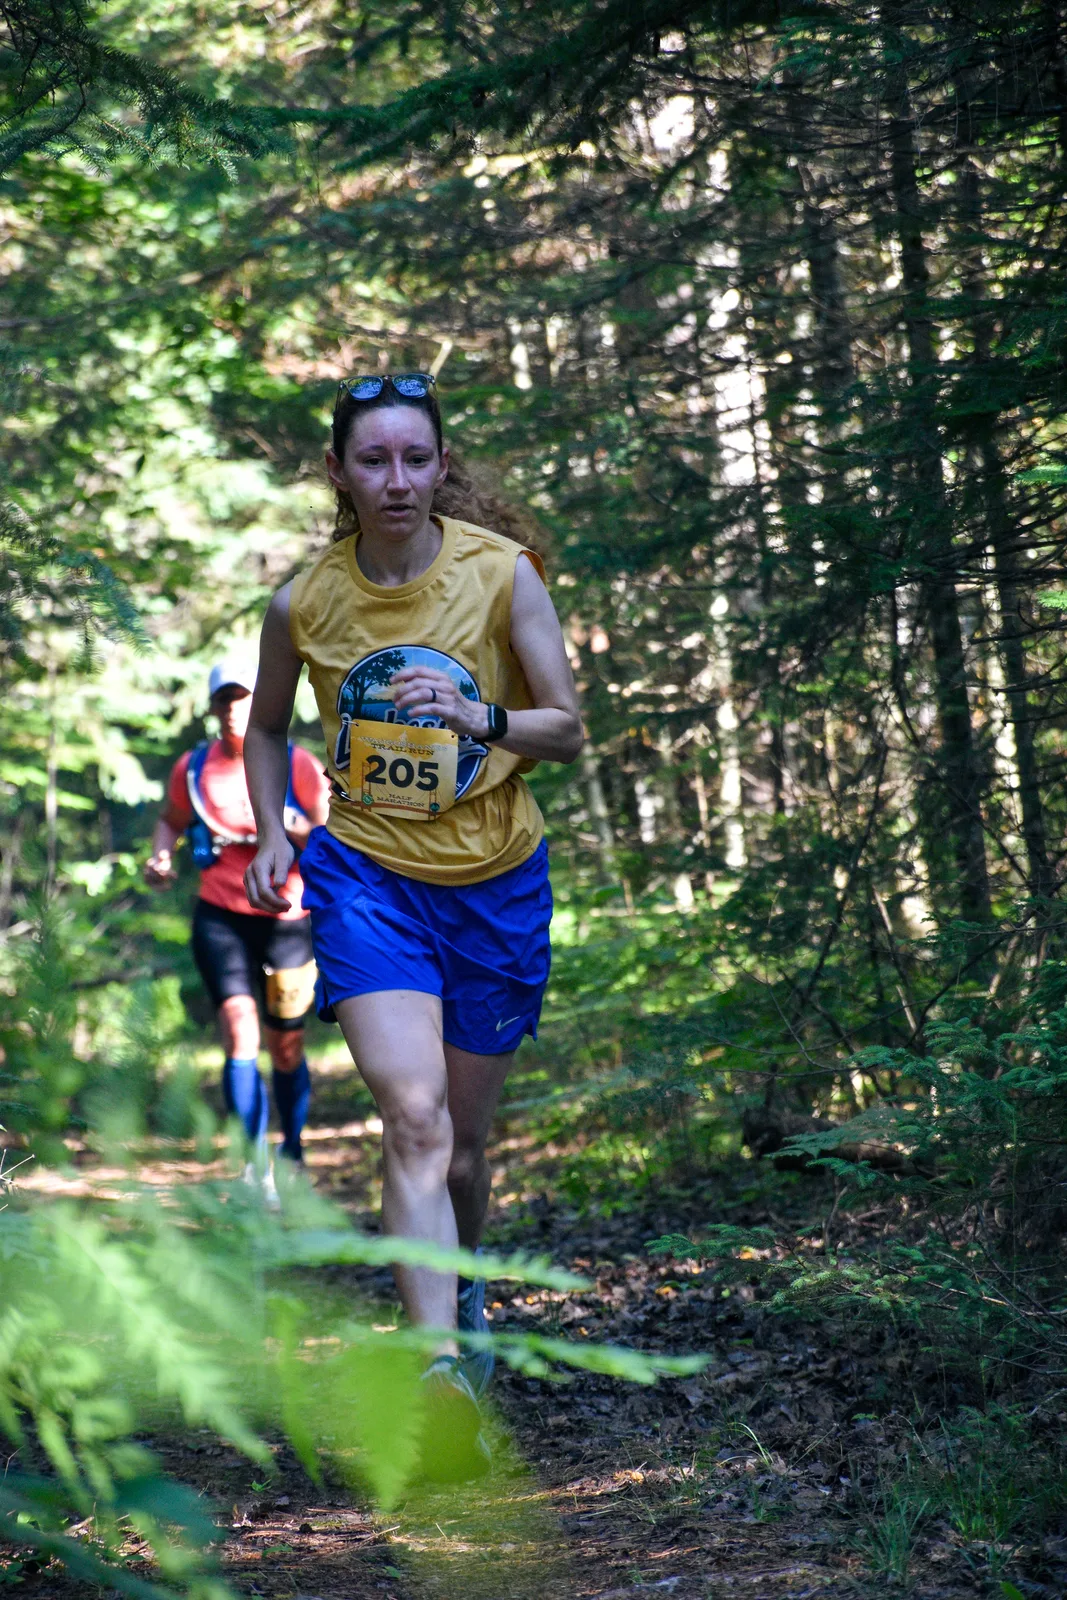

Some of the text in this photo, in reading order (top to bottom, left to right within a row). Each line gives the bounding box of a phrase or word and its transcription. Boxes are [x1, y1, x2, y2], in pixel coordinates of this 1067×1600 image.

[370, 743, 435, 756] TRAIL RUN
[365, 755, 439, 791] 205
[376, 796, 425, 807] MARATHON
[388, 793, 412, 801] HALF
